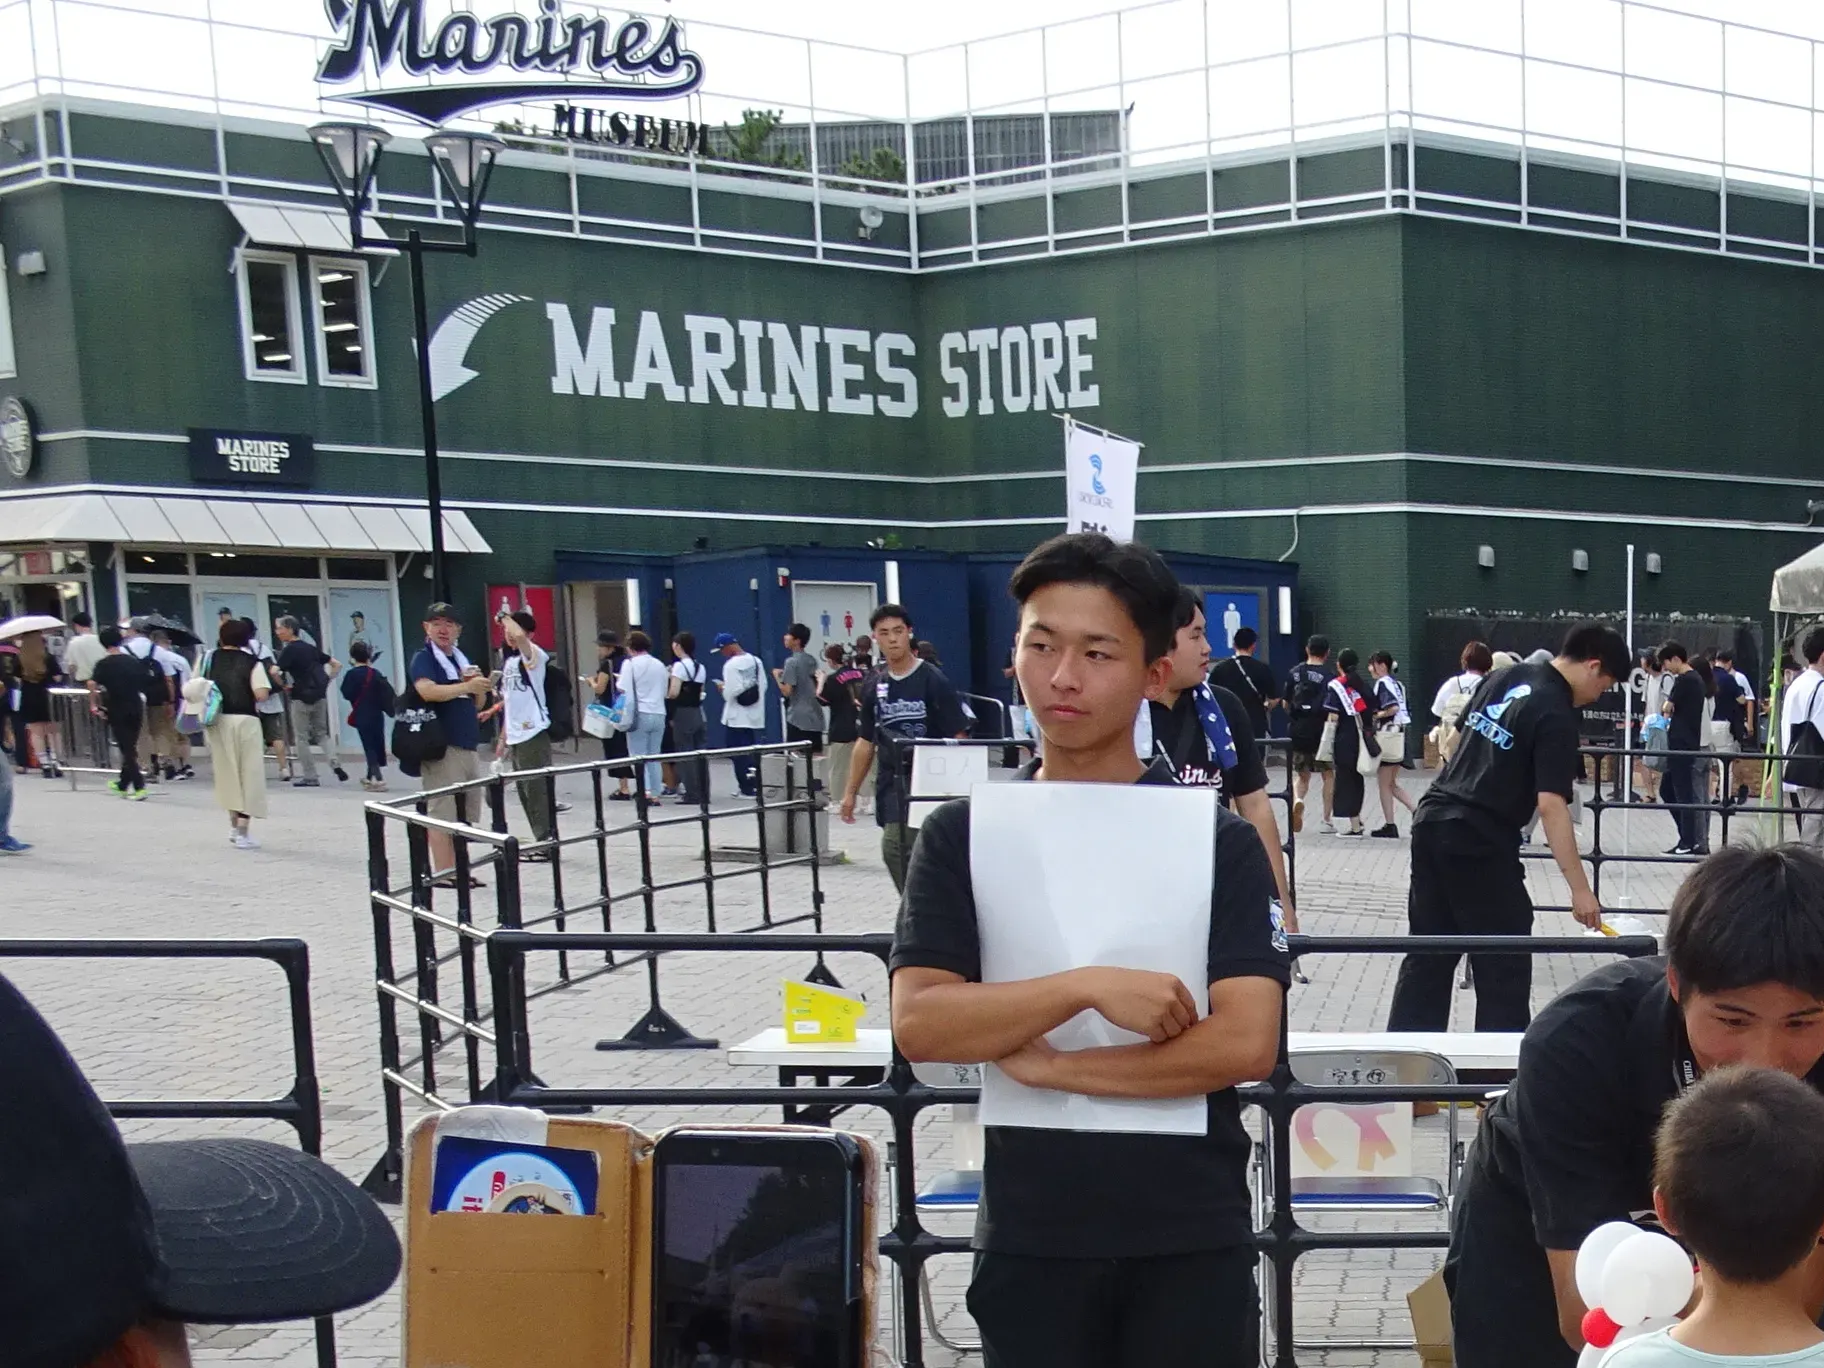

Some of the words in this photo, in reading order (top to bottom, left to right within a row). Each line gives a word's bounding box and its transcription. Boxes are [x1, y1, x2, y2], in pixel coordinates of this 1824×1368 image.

[314, 0, 706, 84] Marines
[553, 104, 710, 156] MUSEUM
[547, 302, 919, 418] MARINES
[939, 317, 1100, 418] STORE
[216, 437, 290, 460] MARINES
[228, 455, 281, 475] STORE
